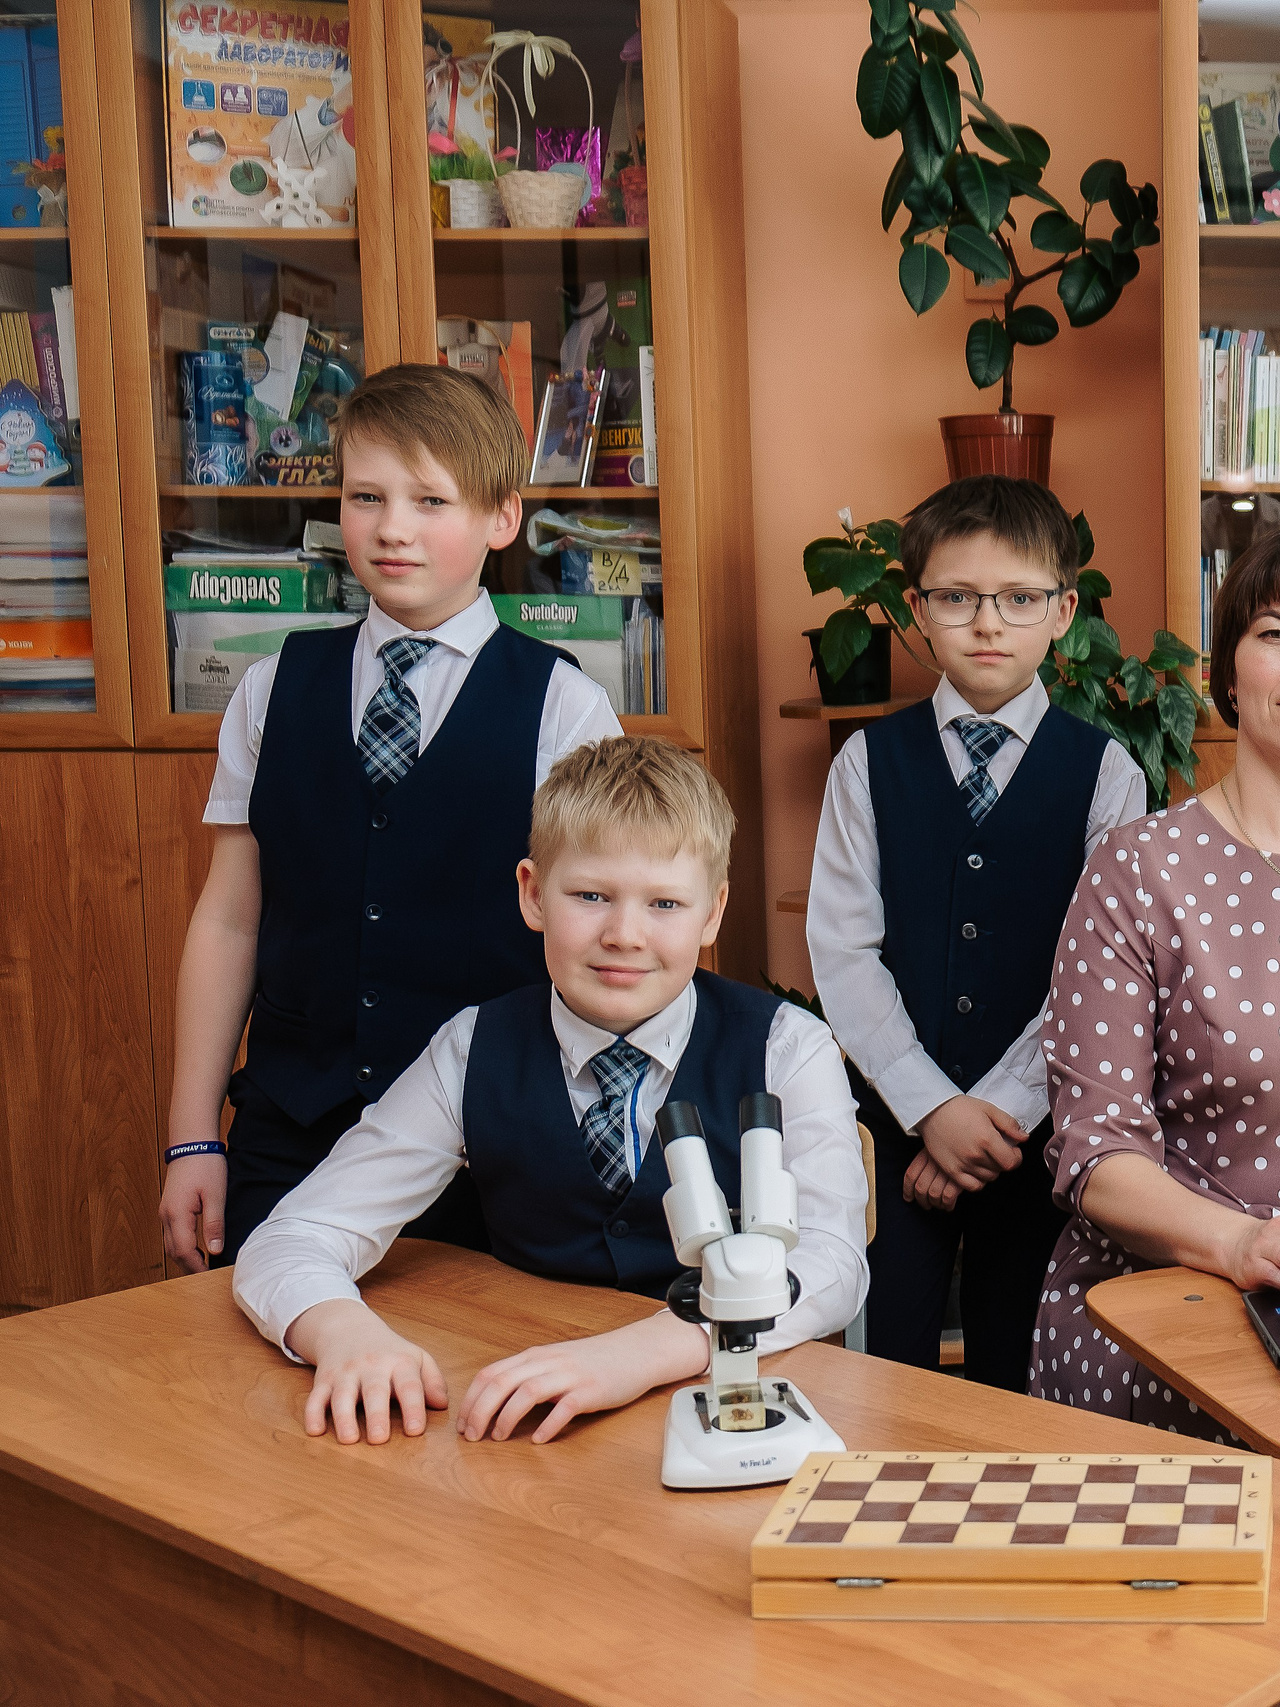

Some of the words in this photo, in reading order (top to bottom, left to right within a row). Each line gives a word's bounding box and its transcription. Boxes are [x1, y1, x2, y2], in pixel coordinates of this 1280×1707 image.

[177, 3, 349, 49] СЕКРЕТНАЯ
[46, 346, 62, 405] МИКРОСКОП
[268, 455, 334, 468] ЭЛЕКТРО
[189, 571, 281, 606] SvetoCopy
[520, 602, 579, 624] SvetoCopy
